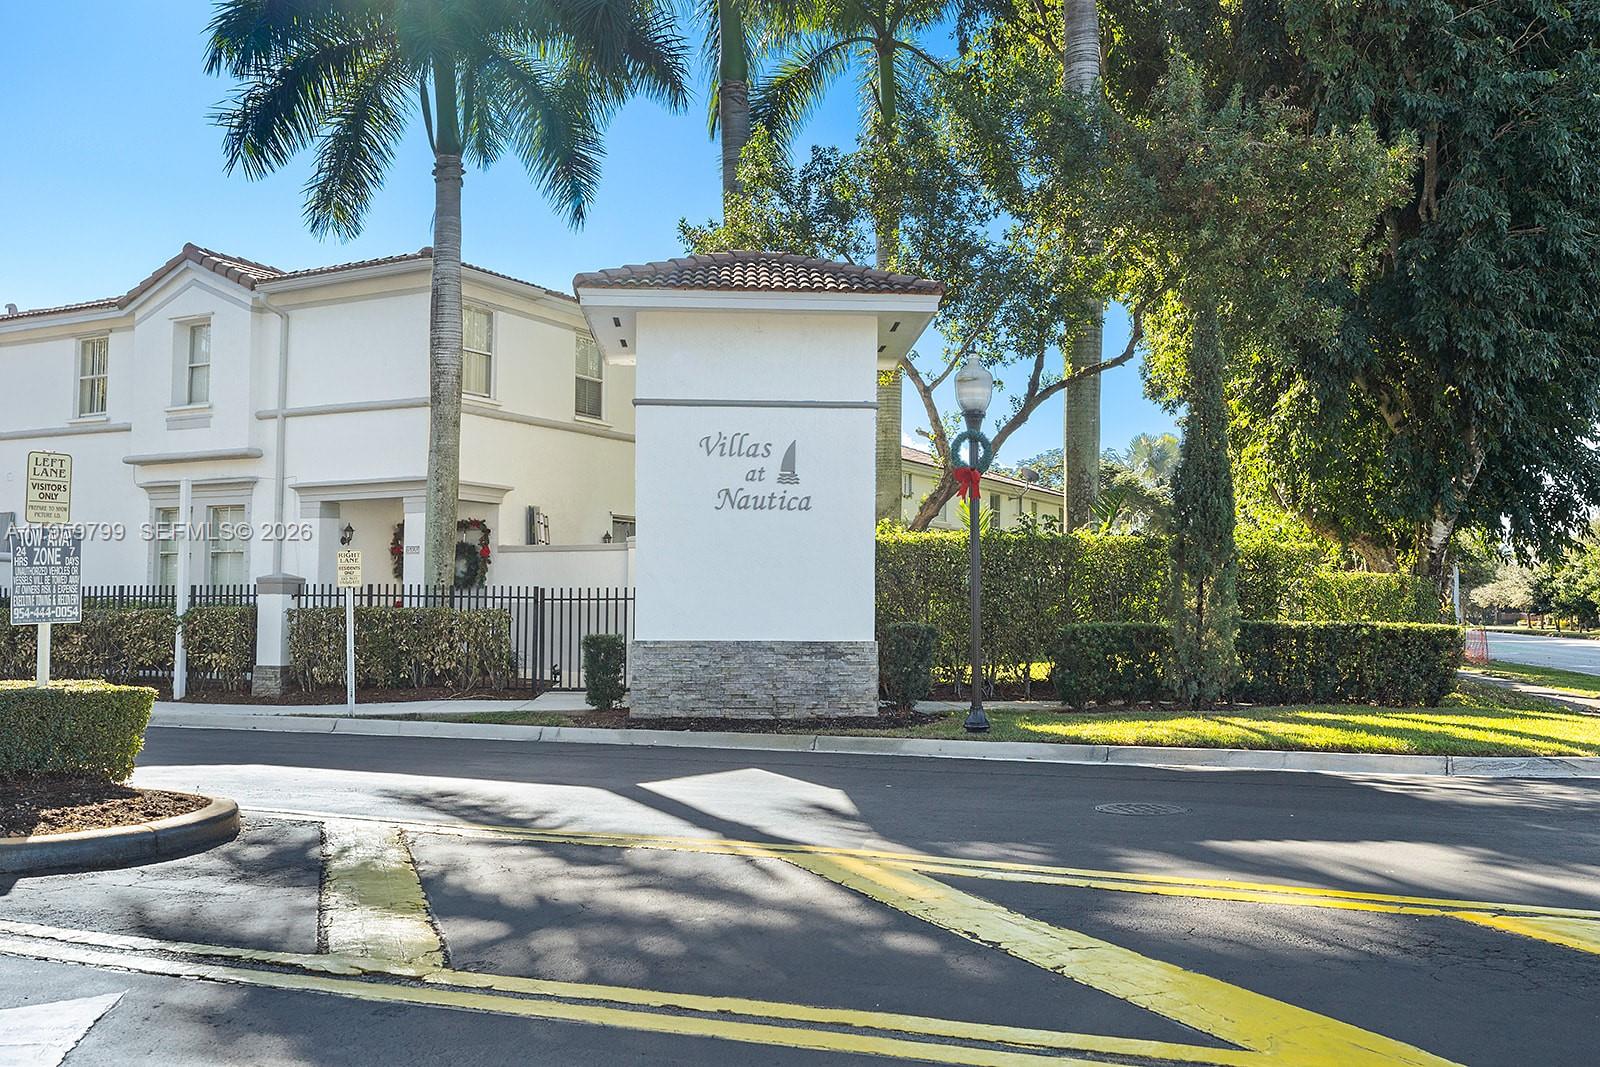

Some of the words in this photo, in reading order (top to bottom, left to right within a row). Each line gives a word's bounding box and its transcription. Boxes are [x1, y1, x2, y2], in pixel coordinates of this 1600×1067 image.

[699, 431, 772, 458] Villas
[35, 457, 66, 468] LEFT
[33, 467, 66, 478] LANE
[745, 466, 766, 482] at
[31, 482, 67, 492] VISITORS
[38, 492, 59, 500] ONLY
[714, 487, 813, 511] Nautica
[16, 546, 27, 556] 24
[33, 547, 62, 566] ZONE
[69, 547, 76, 556] 7
[14, 557, 29, 567] HRS
[64, 557, 80, 566] DAYS
[71, 566, 78, 575] OR
[44, 576, 50, 584] BE
[14, 606, 79, 619] 954-444-0054
